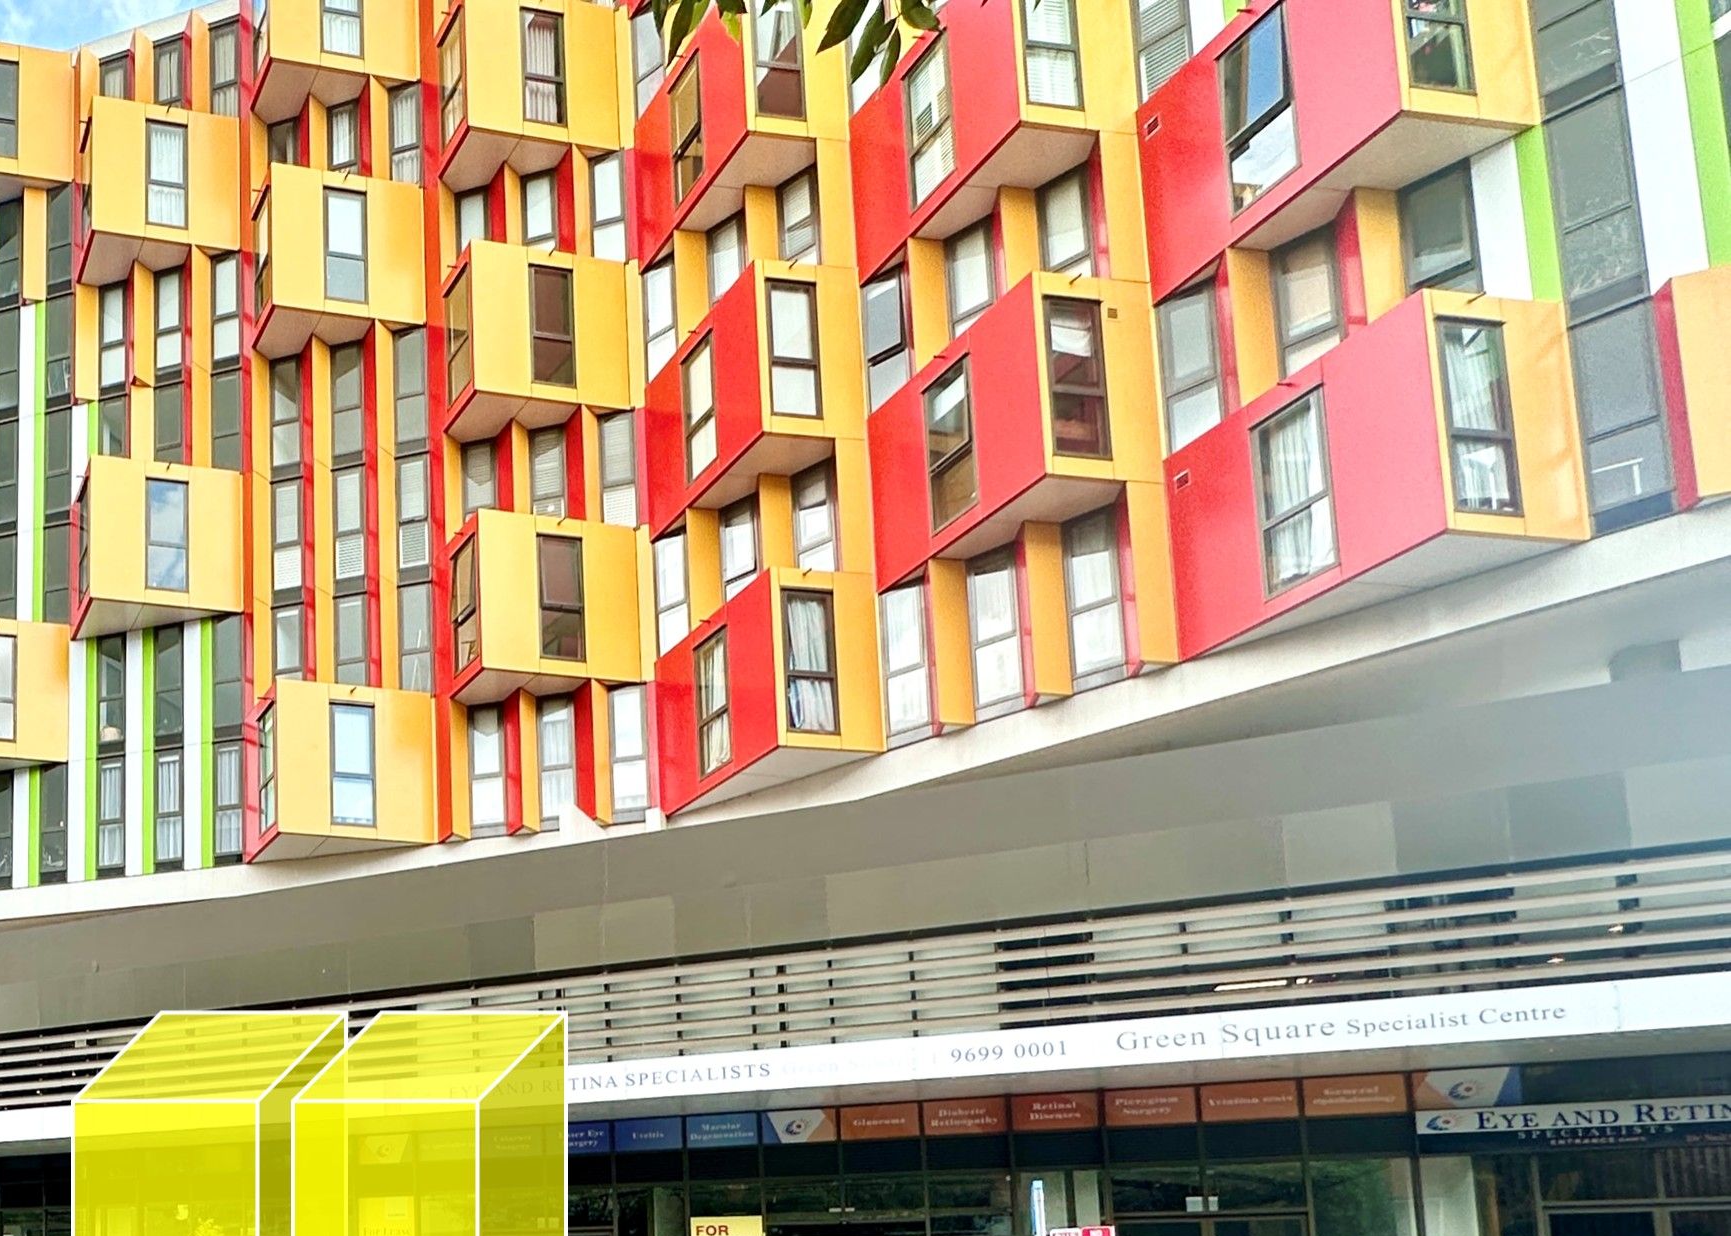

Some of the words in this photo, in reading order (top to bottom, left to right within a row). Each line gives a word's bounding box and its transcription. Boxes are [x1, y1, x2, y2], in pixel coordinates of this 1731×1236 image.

[1117, 1031, 1206, 1052] Green
[1222, 1018, 1336, 1049] Square
[1347, 1012, 1469, 1037] Specialist
[1479, 1004, 1567, 1025] Centre
[950, 1045, 1004, 1063] 9699
[1014, 1039, 1067, 1058] 0001
[625, 1062, 771, 1087] SPECIALISTS
[1476, 1110, 1539, 1130] EYE
[1551, 1107, 1619, 1127] AND
[1518, 1124, 1674, 1140] SPECIALISTS
[696, 1225, 729, 1236] FOR
